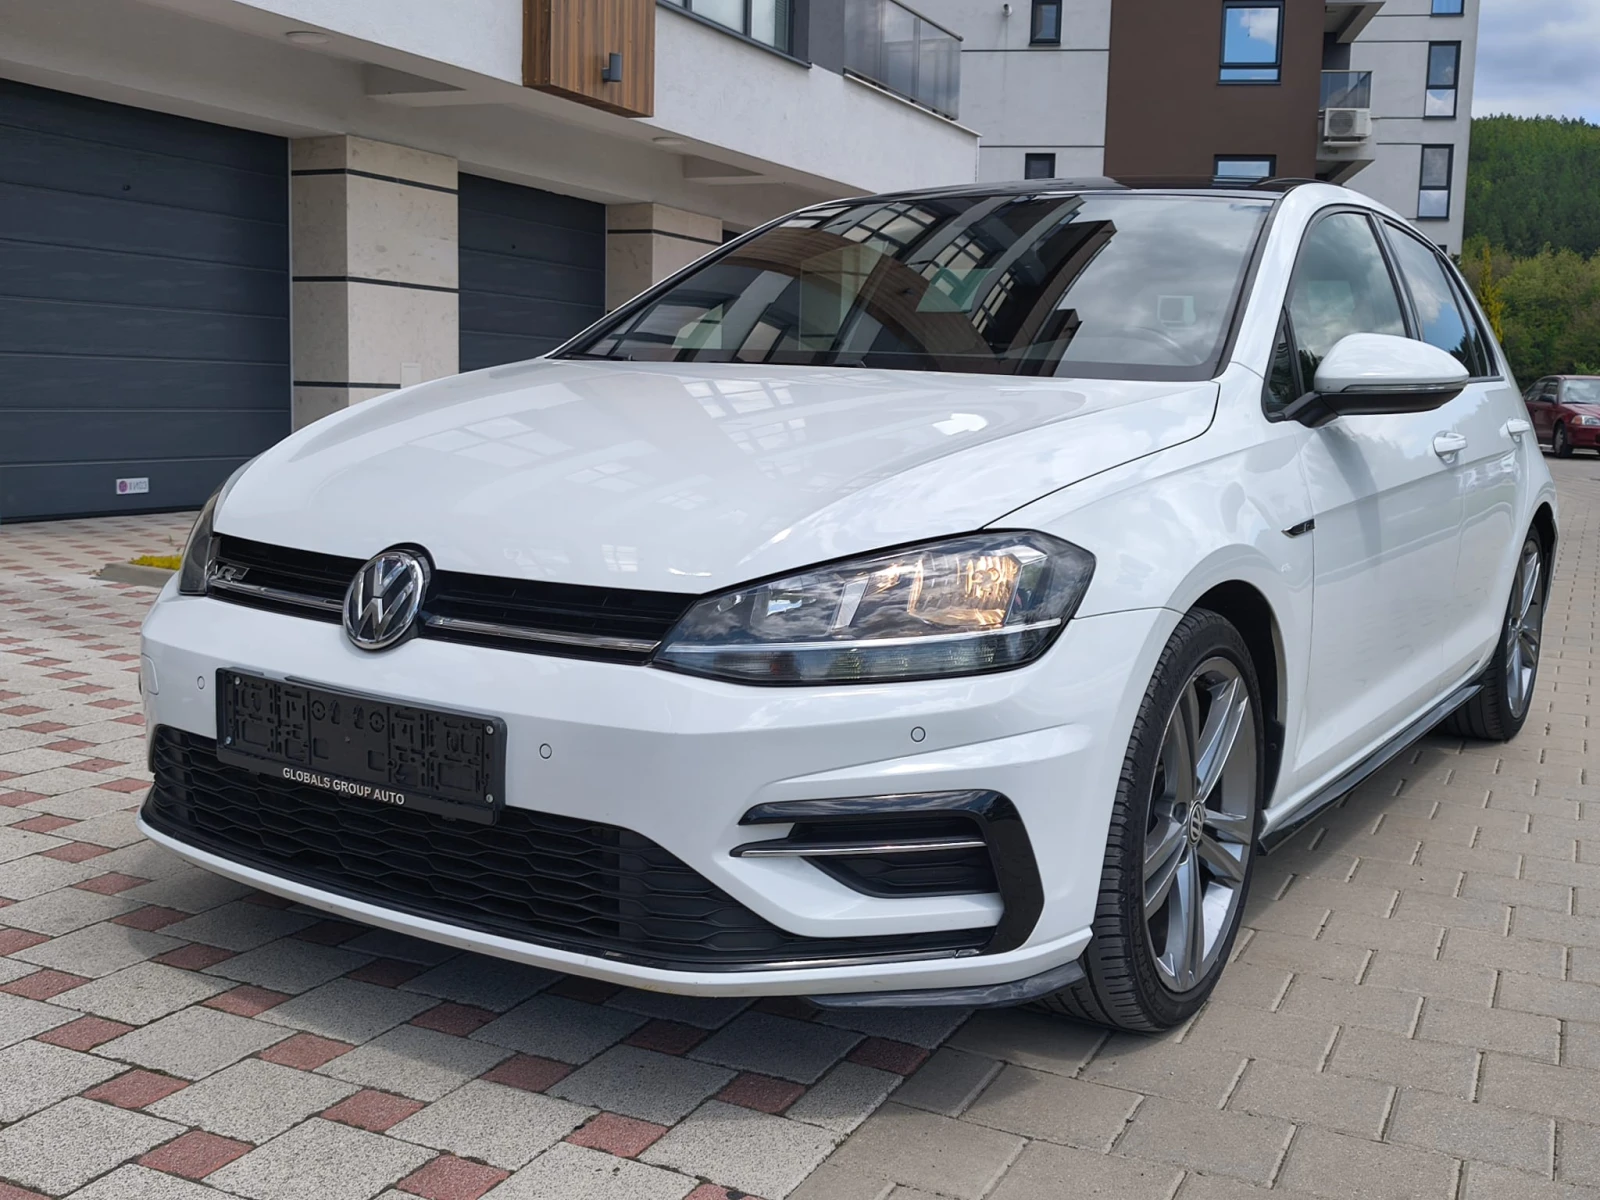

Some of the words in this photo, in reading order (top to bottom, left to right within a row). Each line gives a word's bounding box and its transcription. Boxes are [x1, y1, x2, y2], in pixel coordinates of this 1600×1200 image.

[282, 767, 331, 789] GLOBALS
[332, 779, 372, 798] GROUP
[373, 788, 405, 806] AUTO
